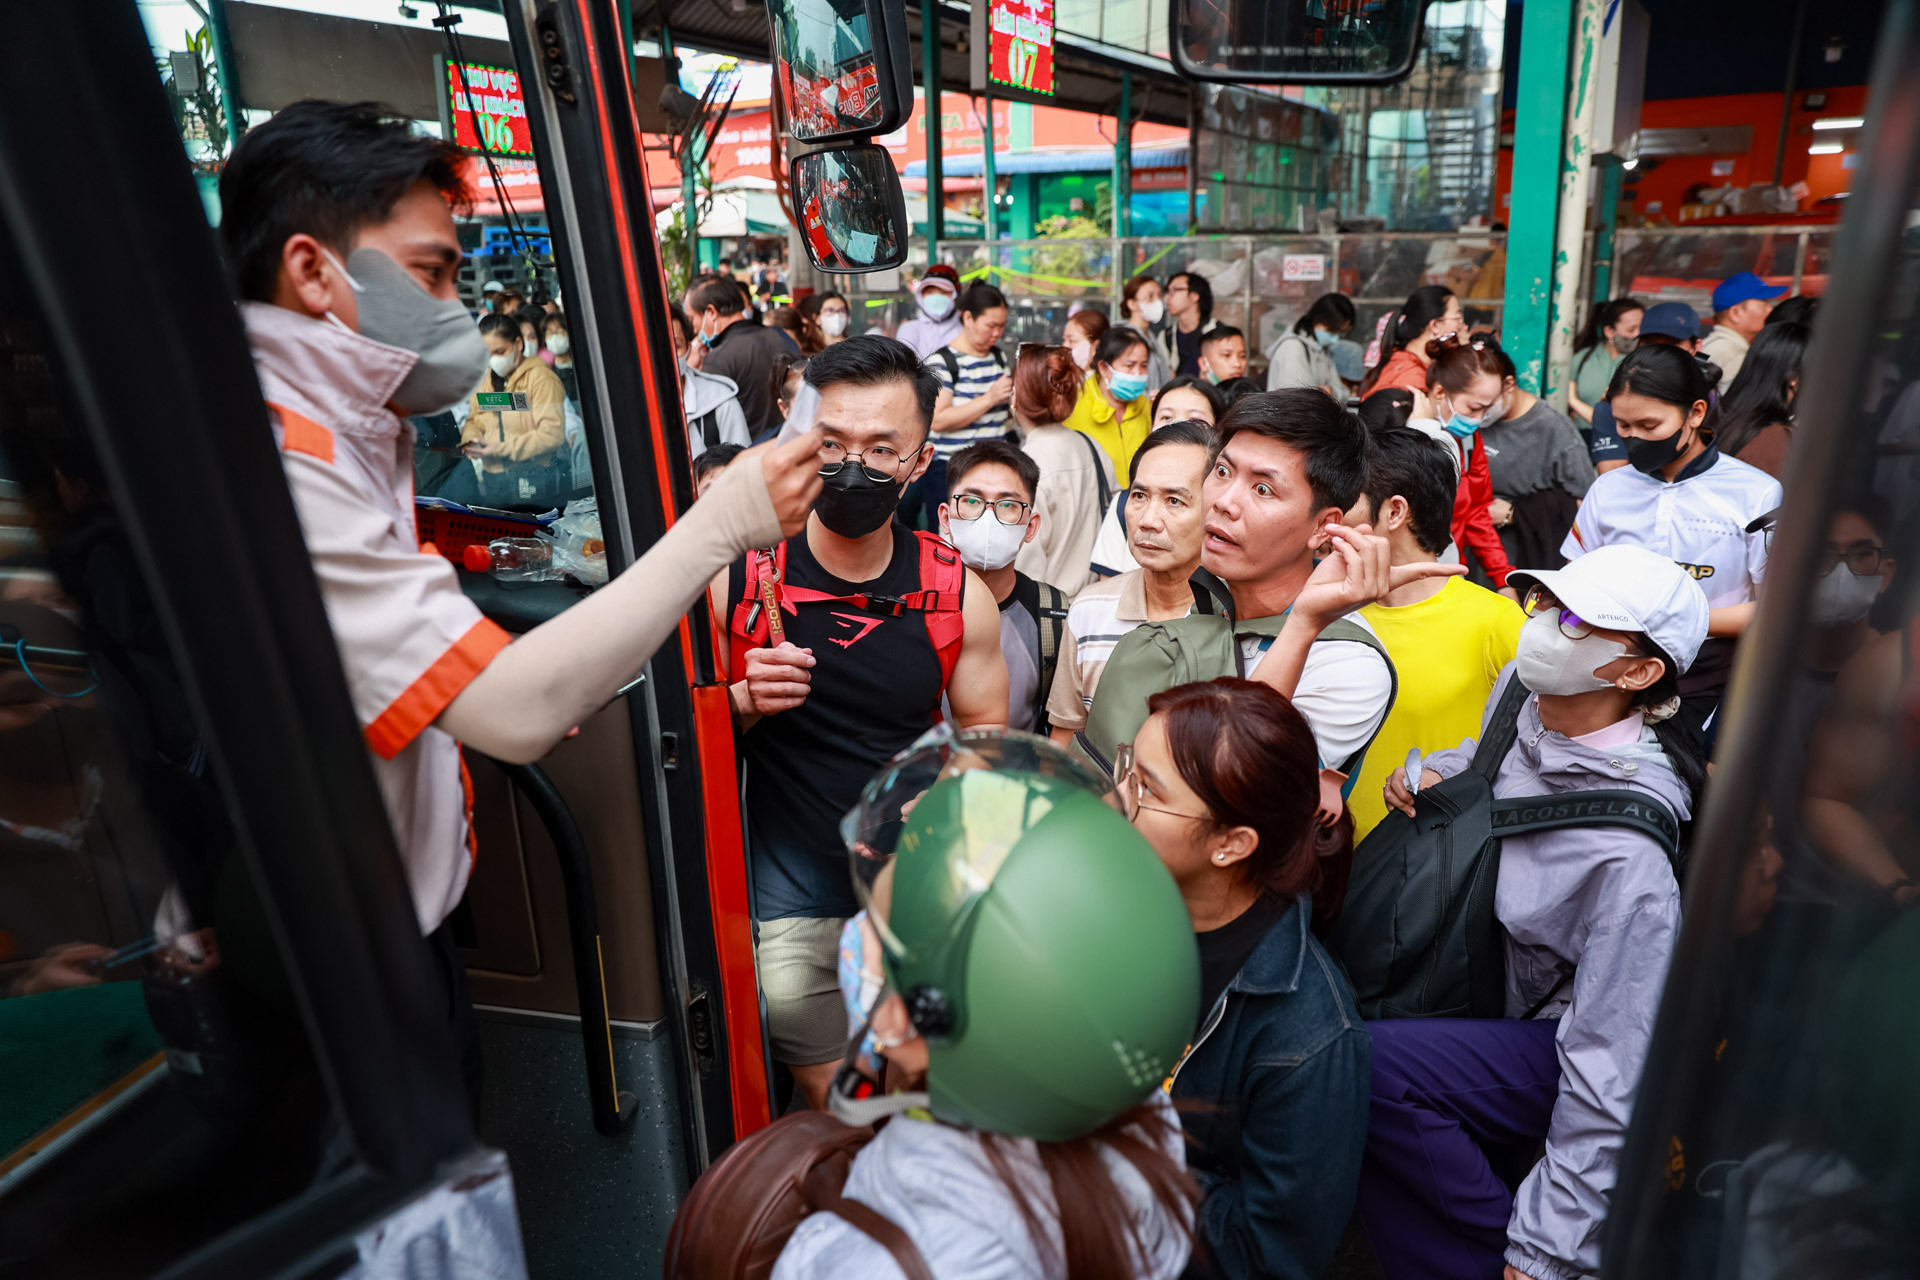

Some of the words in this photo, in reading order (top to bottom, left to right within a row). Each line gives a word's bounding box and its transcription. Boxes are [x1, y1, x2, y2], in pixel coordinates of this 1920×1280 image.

[1008, 36, 1038, 87] 07
[478, 112, 514, 151] 06
[918, 112, 964, 133] FTA
[1677, 562, 1715, 580] AP
[1597, 613, 1629, 623] ARTENGO
[1492, 802, 1605, 826] LACOSTE
